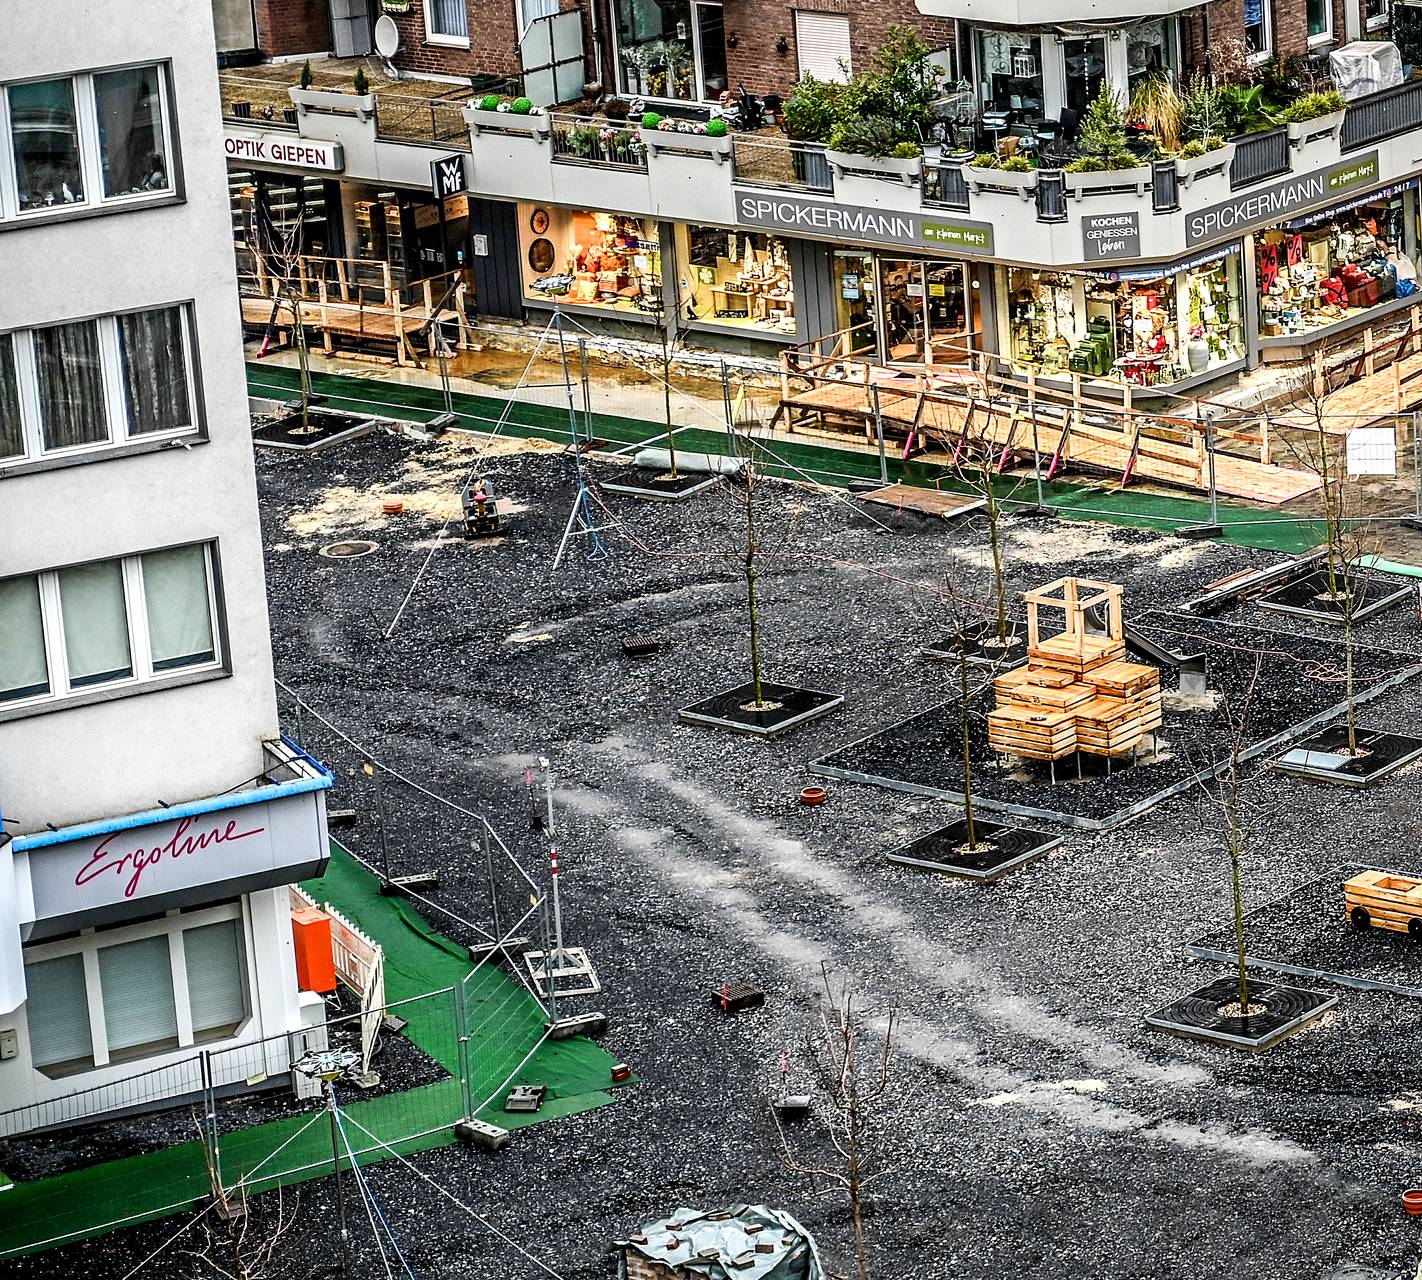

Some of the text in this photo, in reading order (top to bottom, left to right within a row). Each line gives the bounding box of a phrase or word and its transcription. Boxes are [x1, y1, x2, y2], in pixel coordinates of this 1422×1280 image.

[224, 138, 326, 166] OPTIK GIEPEN
[741, 198, 914, 239] SPICKERMANN
[1191, 175, 1324, 238] SPICKERMANN
[1086, 227, 1138, 239] GENIESSEN
[1091, 216, 1132, 228] KOCHEN
[1097, 238, 1125, 256] Leben
[75, 816, 265, 897] Ergoline
